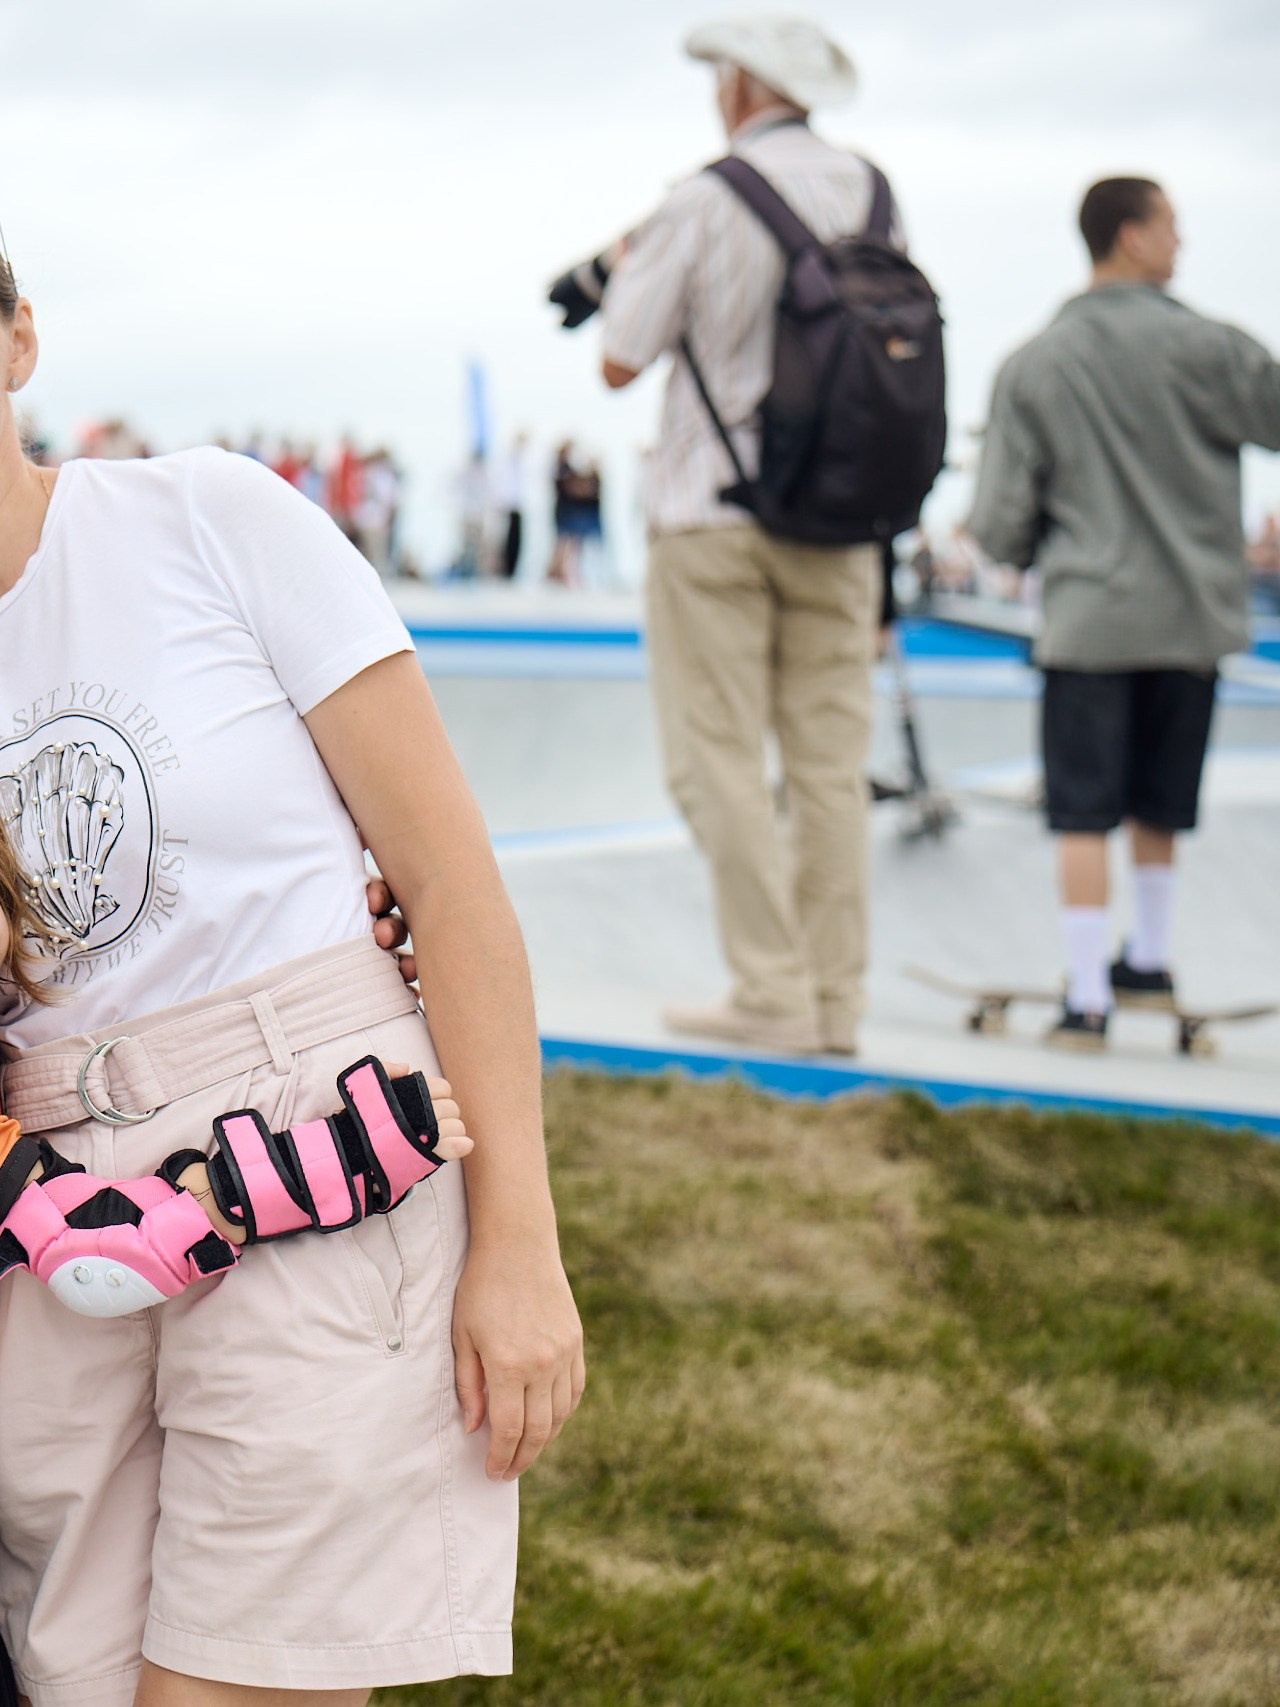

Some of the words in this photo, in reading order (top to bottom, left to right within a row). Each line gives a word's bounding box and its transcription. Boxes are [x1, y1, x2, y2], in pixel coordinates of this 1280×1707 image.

[12, 688, 60, 734] SET
[69, 681, 127, 710] YOU
[118, 702, 182, 778] FREE
[52, 958, 100, 985] RTY
[106, 933, 145, 971] WE
[145, 829, 189, 935] TRUST
